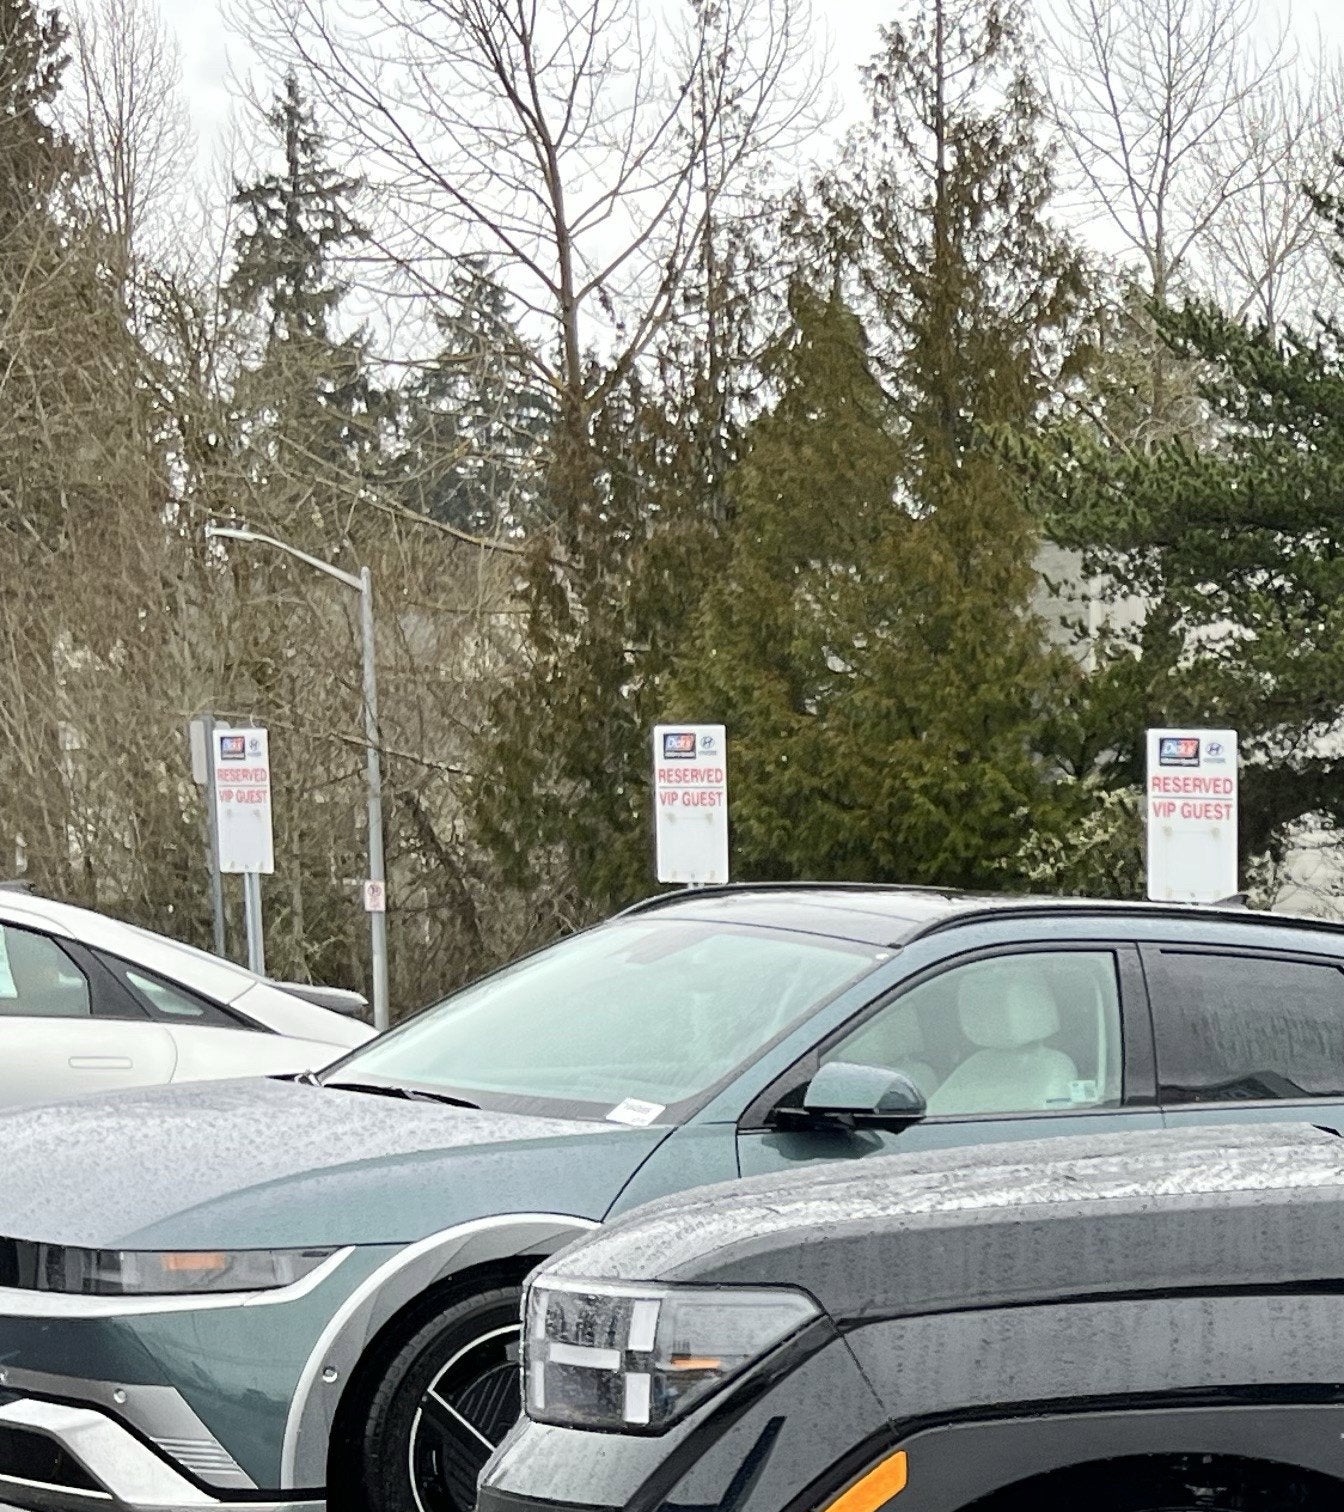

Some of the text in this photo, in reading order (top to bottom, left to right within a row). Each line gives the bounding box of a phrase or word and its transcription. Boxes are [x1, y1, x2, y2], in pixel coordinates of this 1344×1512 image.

[217, 768, 267, 782] RESERVED
[658, 768, 723, 783] RESERVED
[1151, 776, 1233, 794] RESERVED
[660, 791, 723, 806] VIP GUEST
[1152, 802, 1232, 820] VIP GUEST
